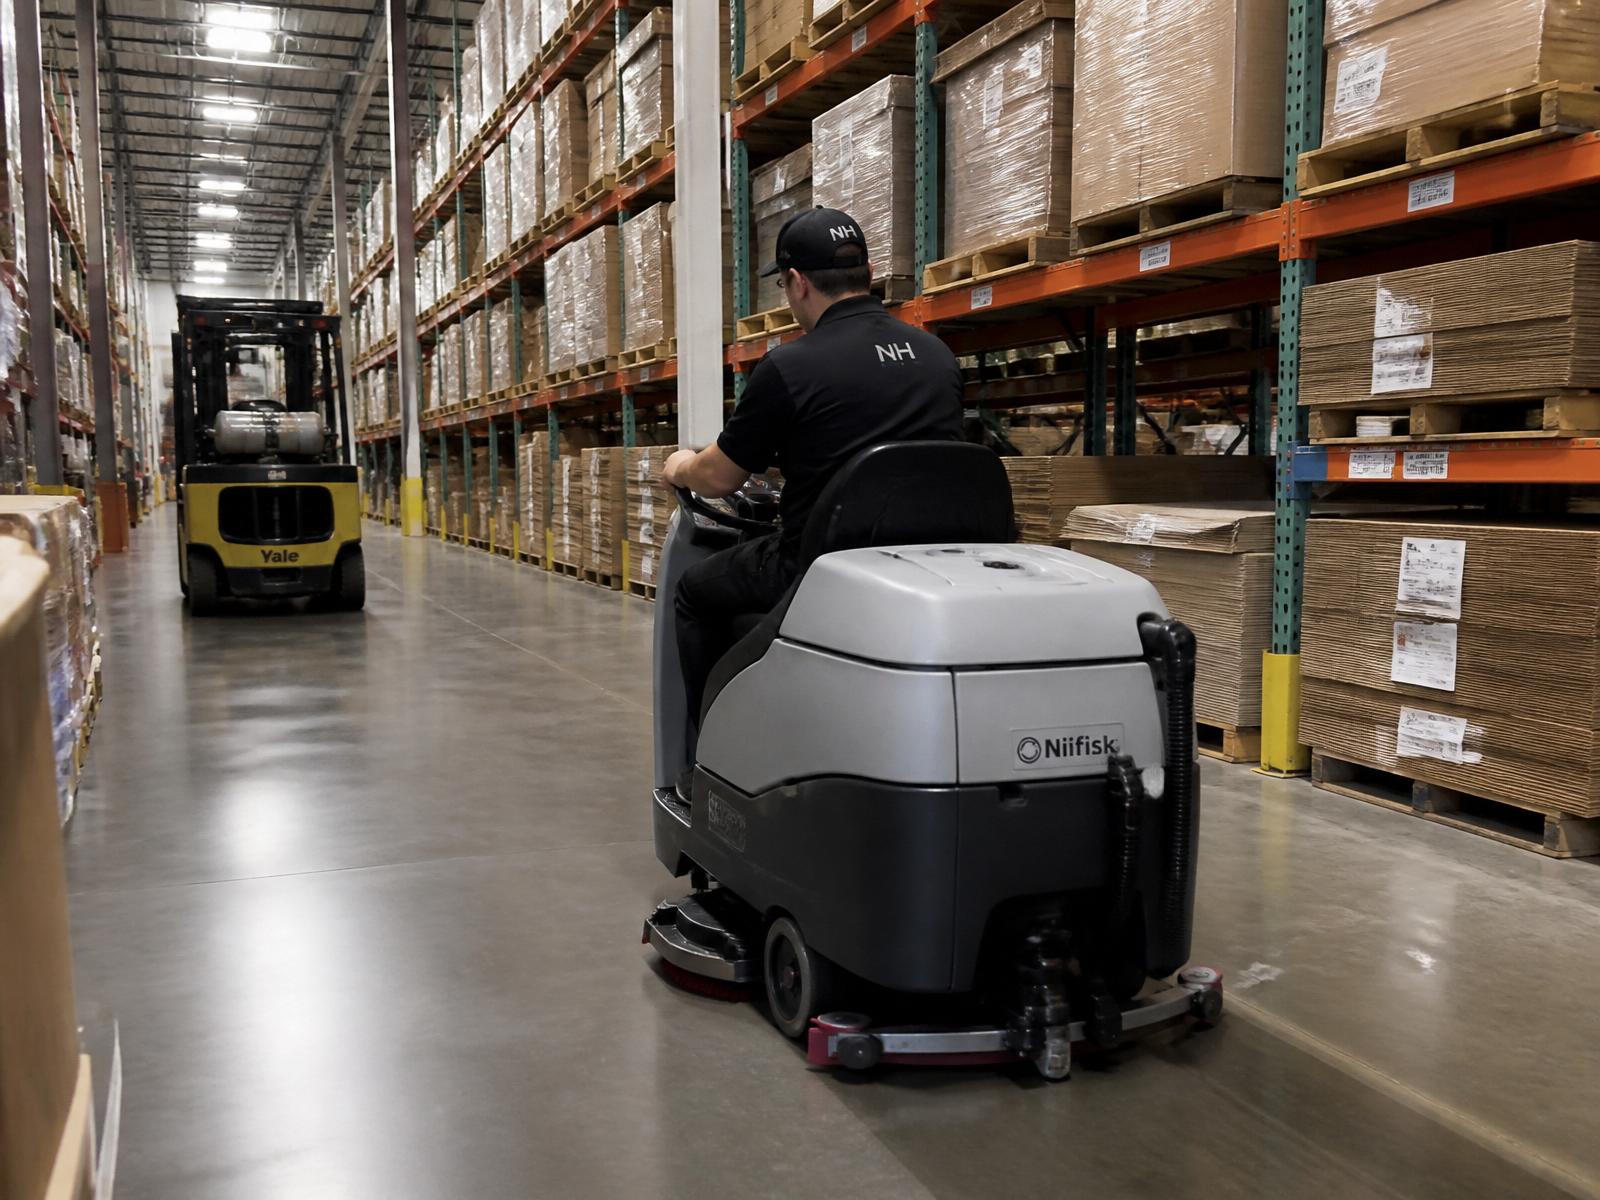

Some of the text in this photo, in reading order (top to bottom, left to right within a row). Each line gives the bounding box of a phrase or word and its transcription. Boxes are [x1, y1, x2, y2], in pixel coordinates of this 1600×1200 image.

[829, 225, 858, 242] NH
[875, 342, 916, 362] NH
[261, 550, 299, 563] Yale
